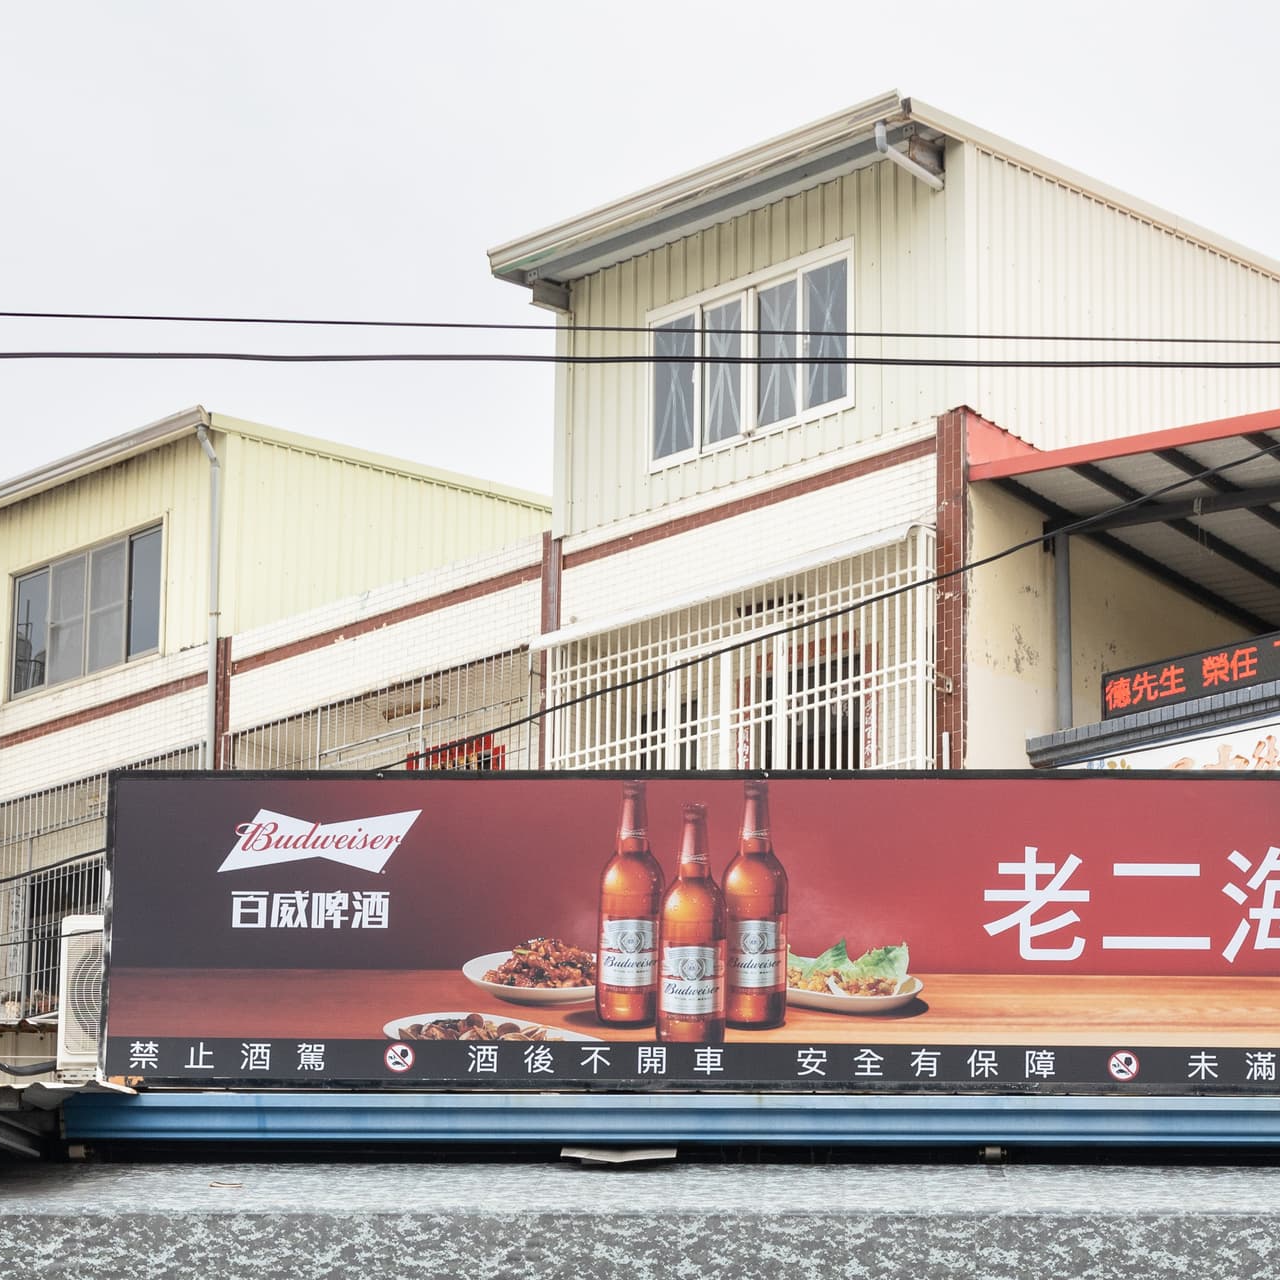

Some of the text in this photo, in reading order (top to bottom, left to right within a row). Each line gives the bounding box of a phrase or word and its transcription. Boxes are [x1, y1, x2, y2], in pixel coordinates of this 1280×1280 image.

[1105, 667, 1187, 711] 德先生
[1201, 647, 1258, 688] 榮任
[234, 821, 402, 852] Budweiser
[230, 890, 391, 929] 百威啤酒
[664, 983, 720, 997] Budweiser
[129, 1040, 326, 1072] 禁止酒駕
[467, 1044, 726, 1076] 酒後不開車
[795, 1046, 1057, 1079] 安全有保障
